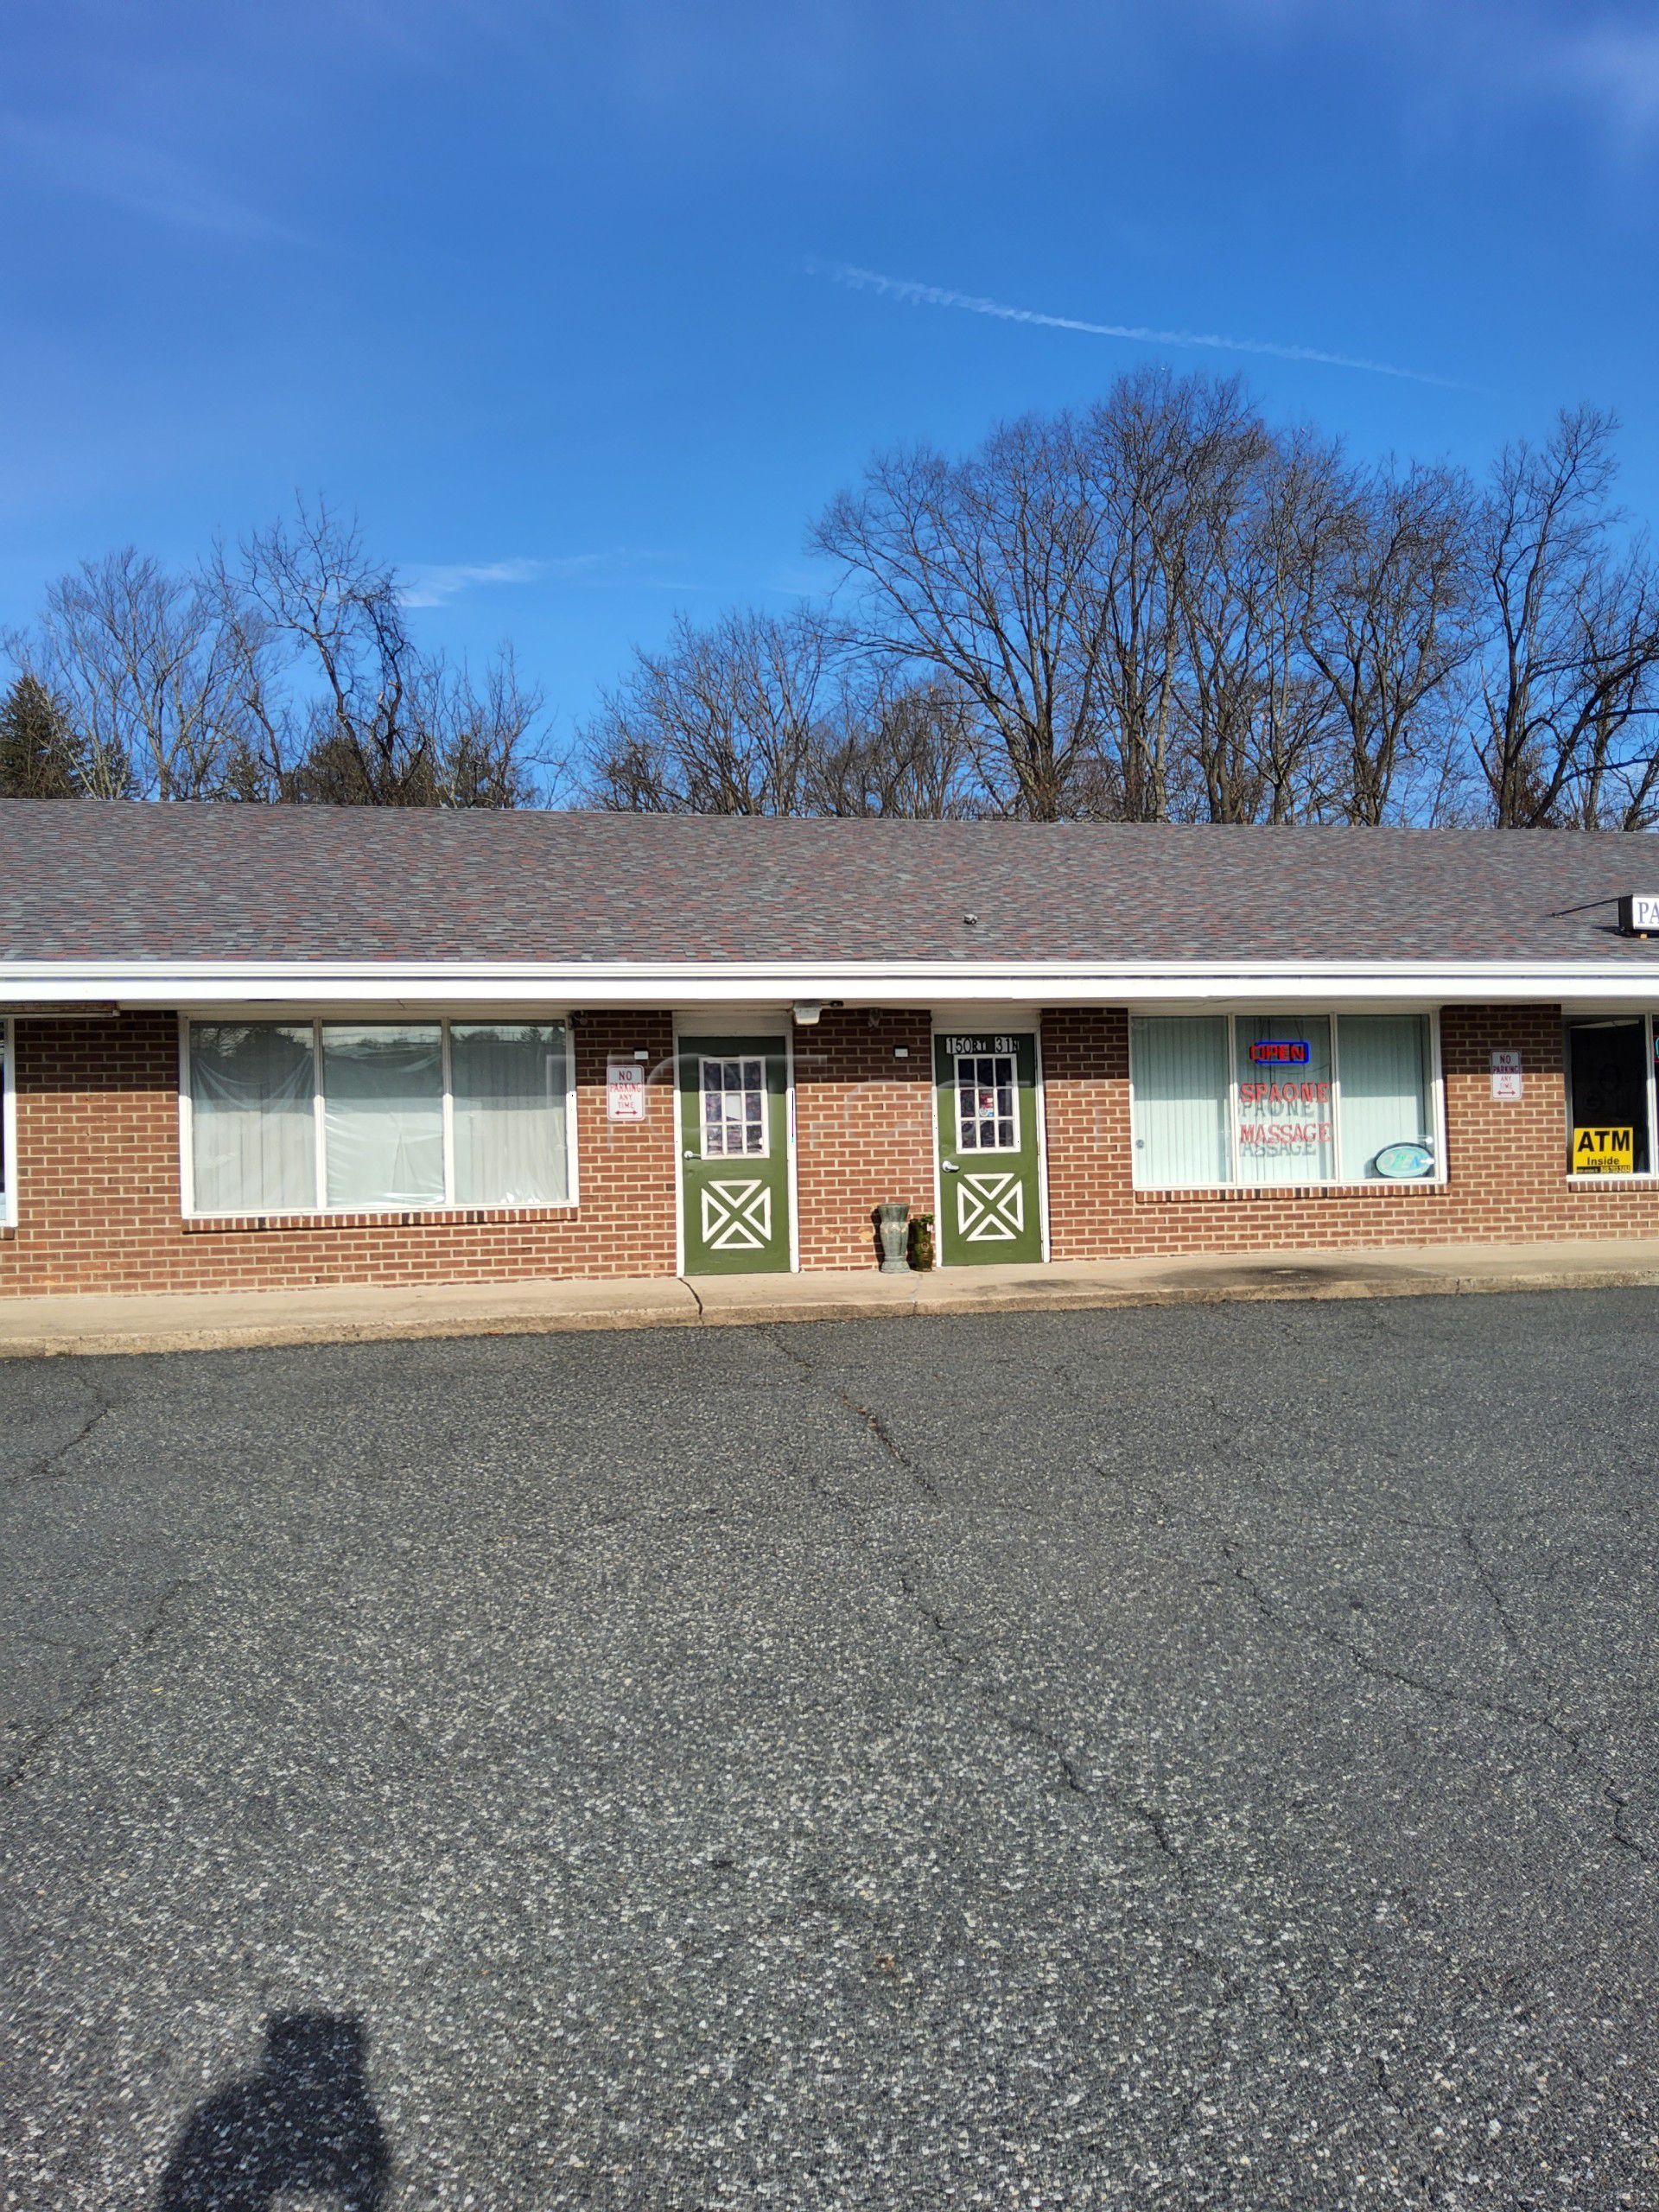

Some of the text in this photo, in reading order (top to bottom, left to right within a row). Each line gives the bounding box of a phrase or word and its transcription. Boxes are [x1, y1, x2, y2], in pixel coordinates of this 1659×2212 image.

[1249, 1044, 1306, 1060] OPEN
[1499, 1055, 1511, 1064] NO
[1492, 1065, 1518, 1074] PARKING
[619, 1071, 632, 1081] NO
[610, 1083, 642, 1092] PARKING
[1240, 1123, 1332, 1143] MASSAGE
[1578, 1130, 1630, 1152] ATM
[1586, 1156, 1620, 1165] Inside
